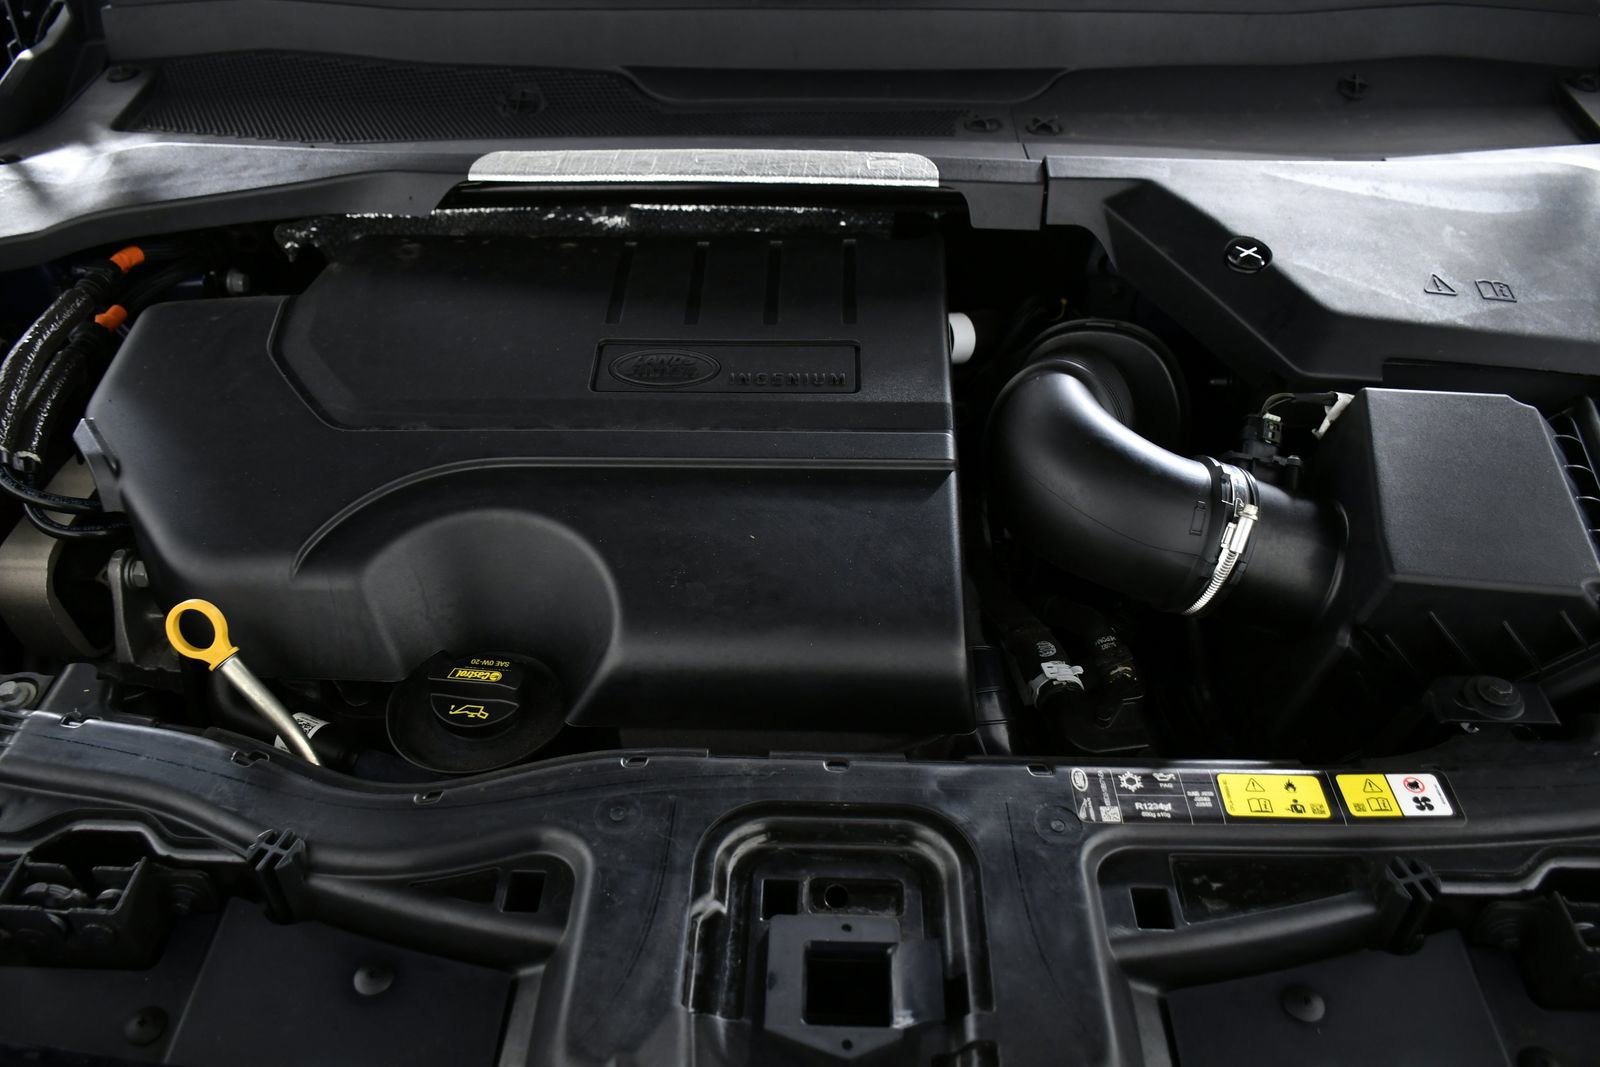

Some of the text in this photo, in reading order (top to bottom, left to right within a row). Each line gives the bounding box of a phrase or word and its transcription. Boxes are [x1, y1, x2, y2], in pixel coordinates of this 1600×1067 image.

[729, 372, 847, 387] INGENIUM
[470, 658, 494, 666] 0W-20
[456, 669, 490, 680] Castrol
